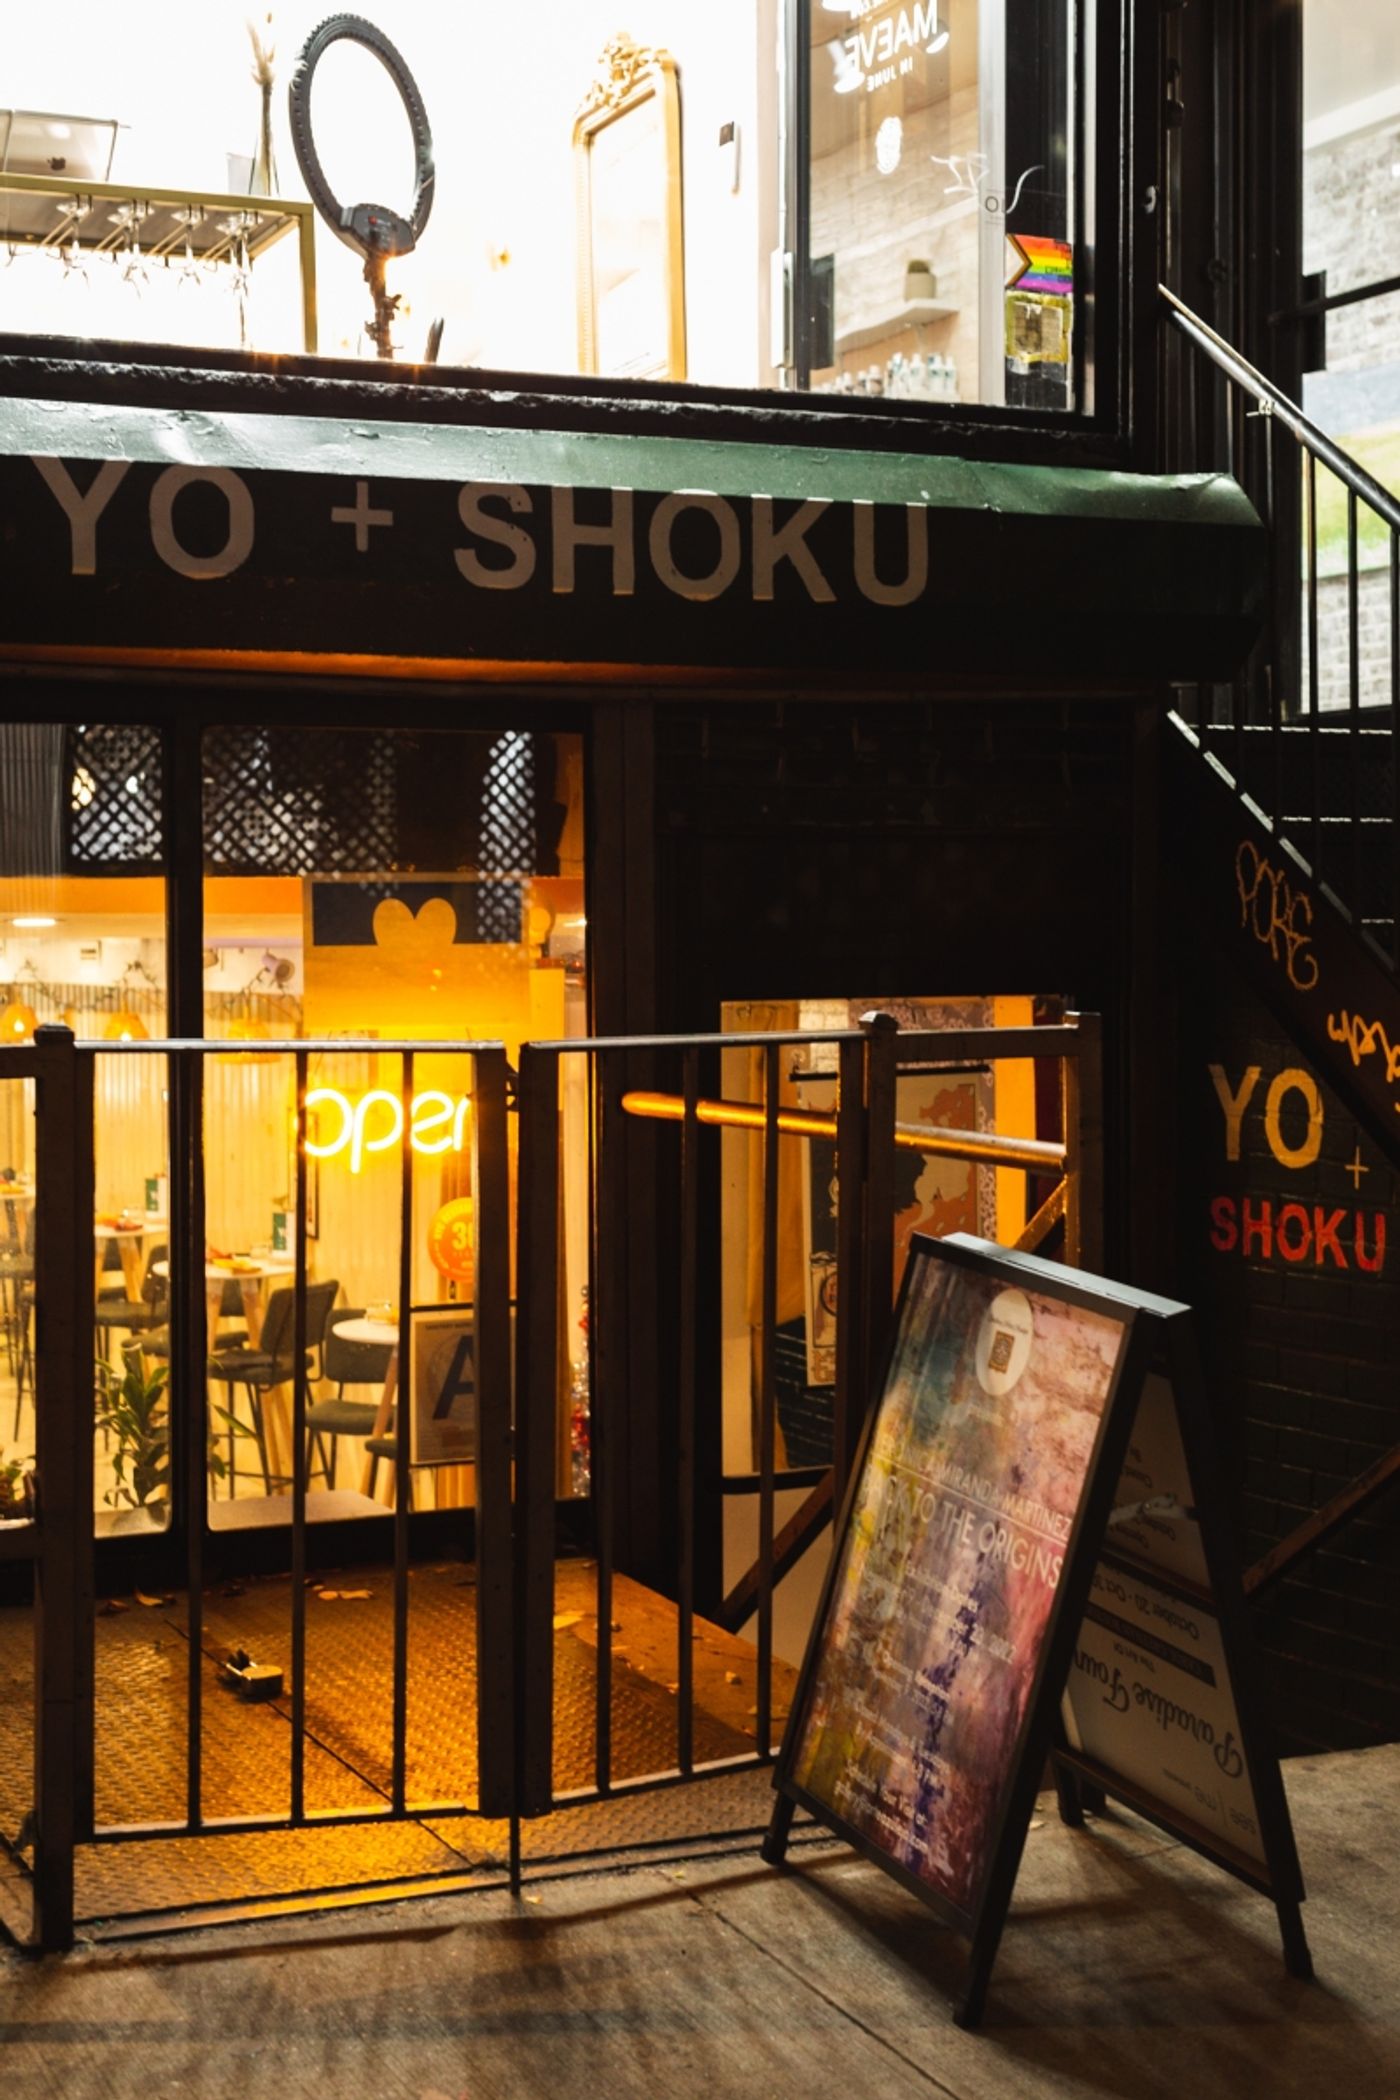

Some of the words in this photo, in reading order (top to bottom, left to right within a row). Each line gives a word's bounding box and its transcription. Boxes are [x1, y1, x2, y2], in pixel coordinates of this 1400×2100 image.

[30, 455, 256, 580] YO
[453, 481, 928, 606] SHOKU
[1209, 1063, 1324, 1168] YO
[1210, 1196, 1386, 1273] SHOKU
[911, 1487, 937, 1523] TO
[940, 1501, 976, 1544] THE
[978, 1521, 1064, 1589] ORIGINS
[940, 1462, 1000, 1504] MIRANDA
[1002, 1494, 1072, 1539] MARTINEZ
[1151, 1600, 1200, 1642] October
[1071, 1641, 1131, 1719] Foun
[1131, 1676, 1246, 1787] Paradise
